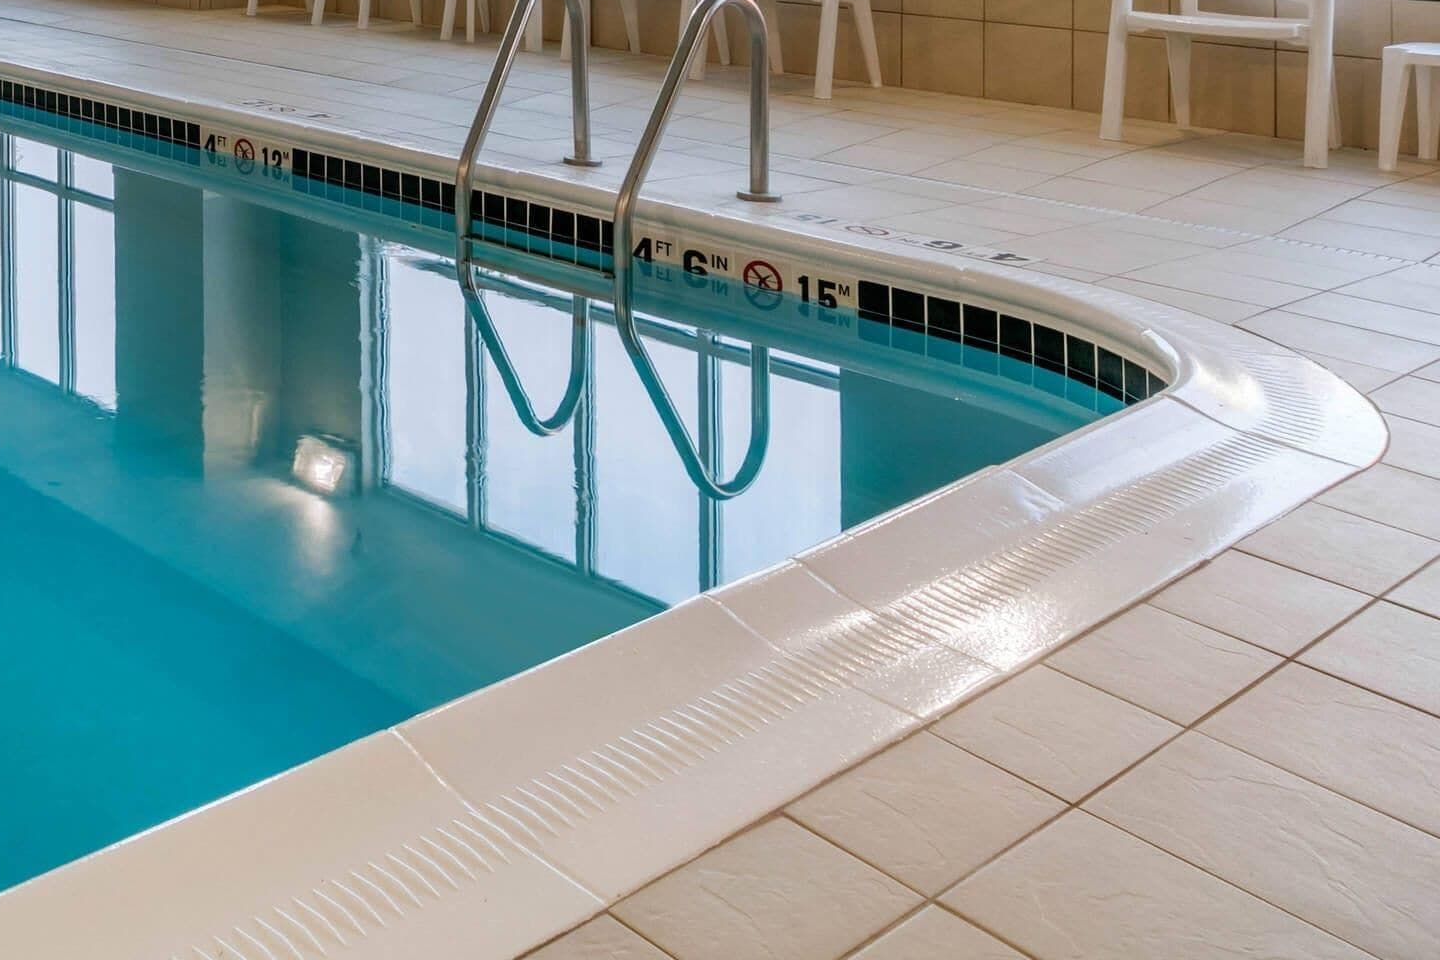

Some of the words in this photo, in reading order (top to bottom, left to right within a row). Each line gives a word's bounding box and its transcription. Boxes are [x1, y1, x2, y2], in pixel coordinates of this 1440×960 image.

[633, 237, 652, 263] 4
[656, 240, 672, 256] FT
[683, 250, 708, 276] 6
[711, 254, 728, 271] IN
[838, 284, 850, 297] M
